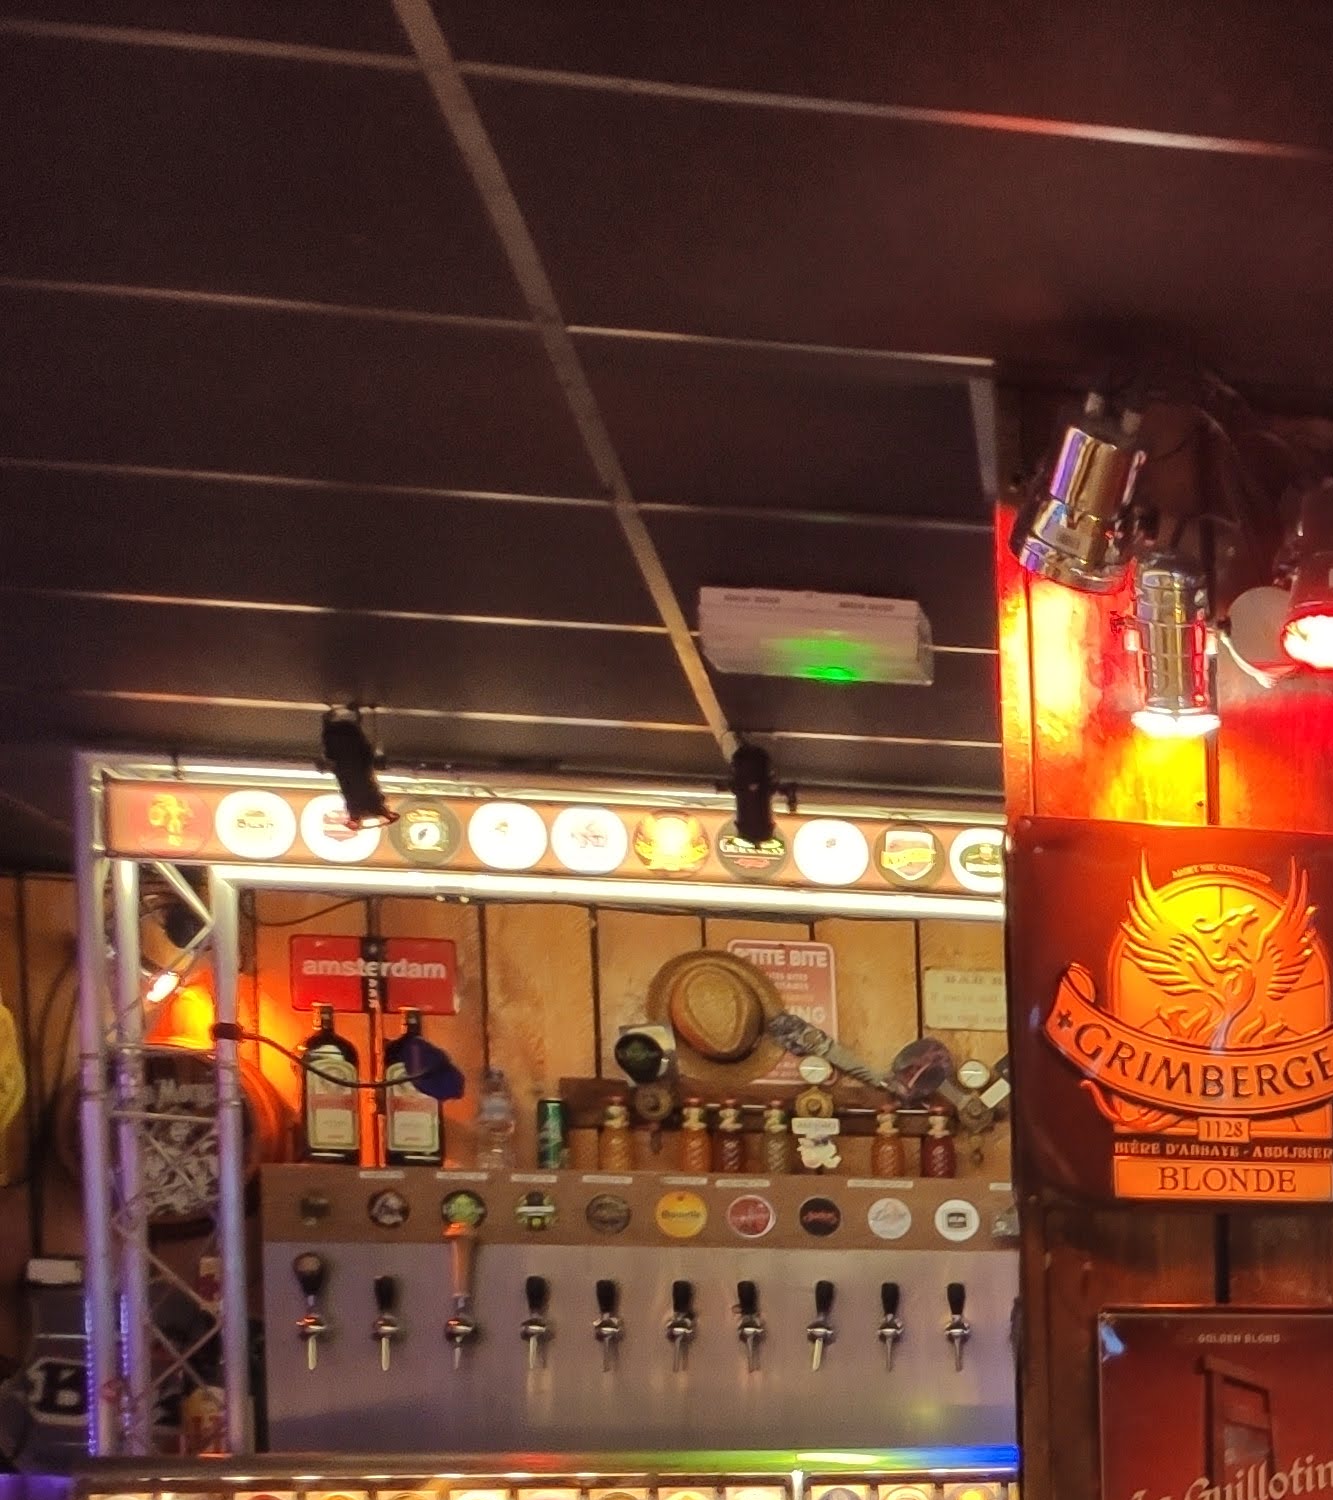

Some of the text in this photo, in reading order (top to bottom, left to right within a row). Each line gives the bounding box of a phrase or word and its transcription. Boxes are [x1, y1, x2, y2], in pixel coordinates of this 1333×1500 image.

[303, 958, 447, 980] amsterdam
[1204, 1119, 1244, 1139] 1128
[1157, 1165, 1298, 1194] BLONDE
